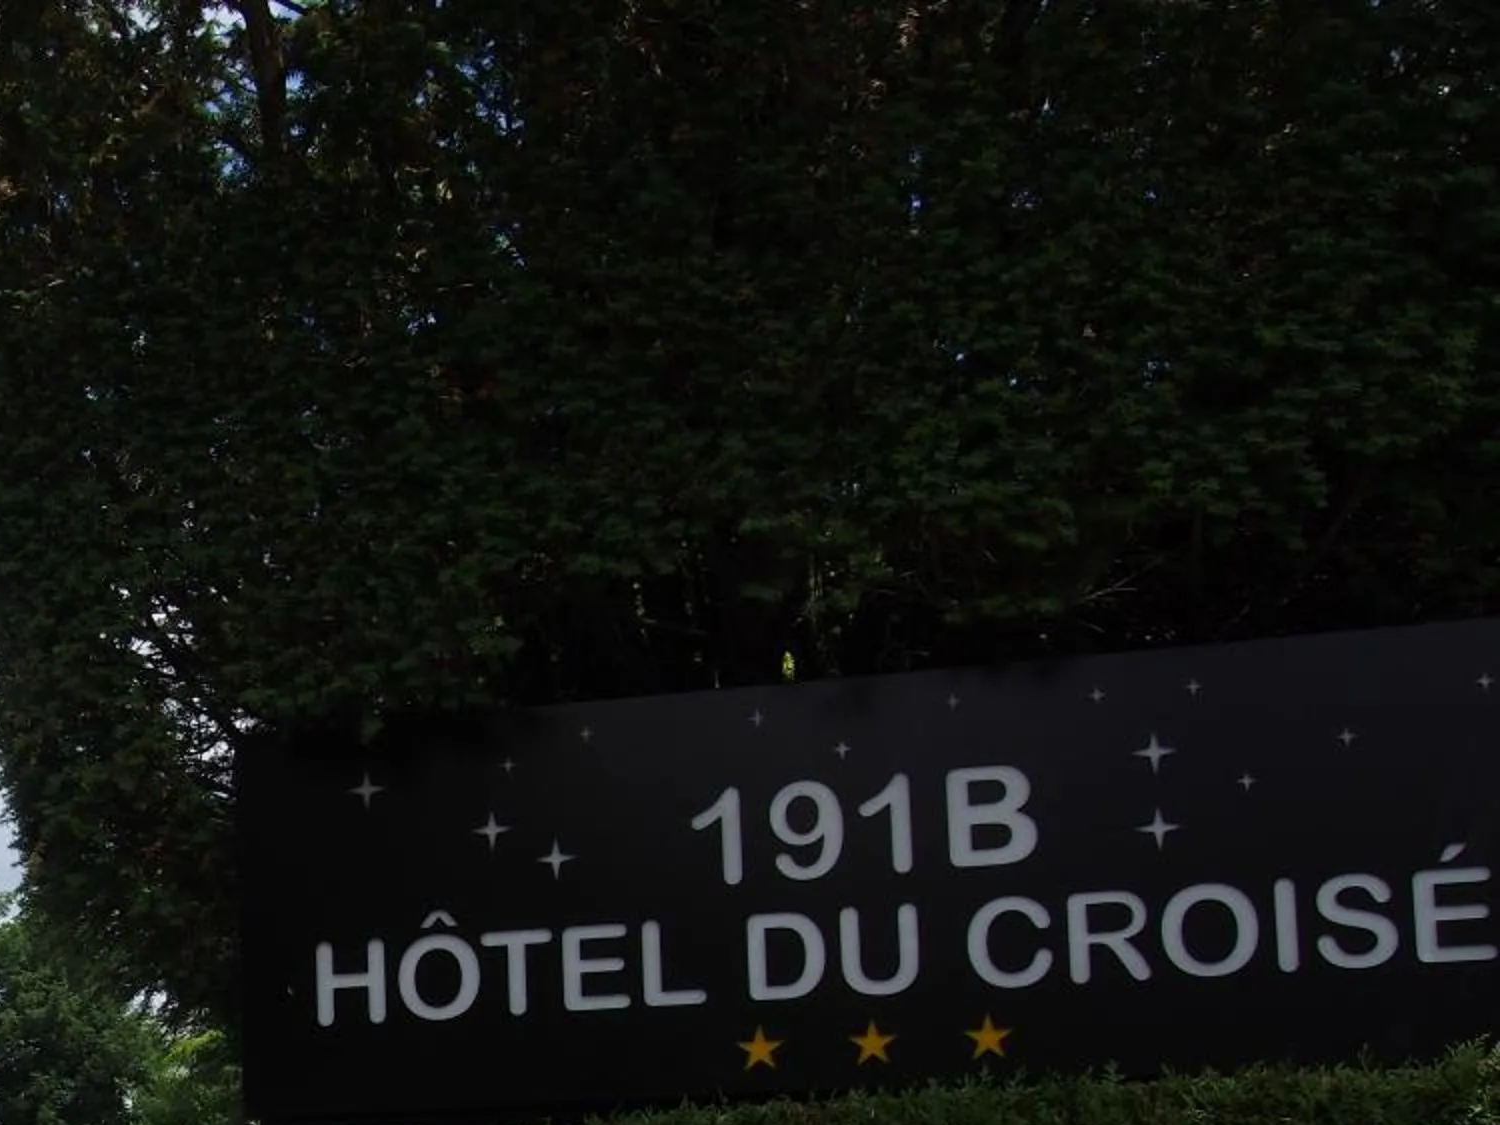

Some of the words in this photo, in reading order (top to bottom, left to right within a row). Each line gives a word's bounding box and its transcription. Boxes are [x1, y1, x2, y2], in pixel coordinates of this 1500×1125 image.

[690, 764, 1040, 886] 191B
[314, 908, 707, 1028] HÔTEL
[746, 902, 920, 1001] DU
[966, 842, 1499, 989] CROISÉ
